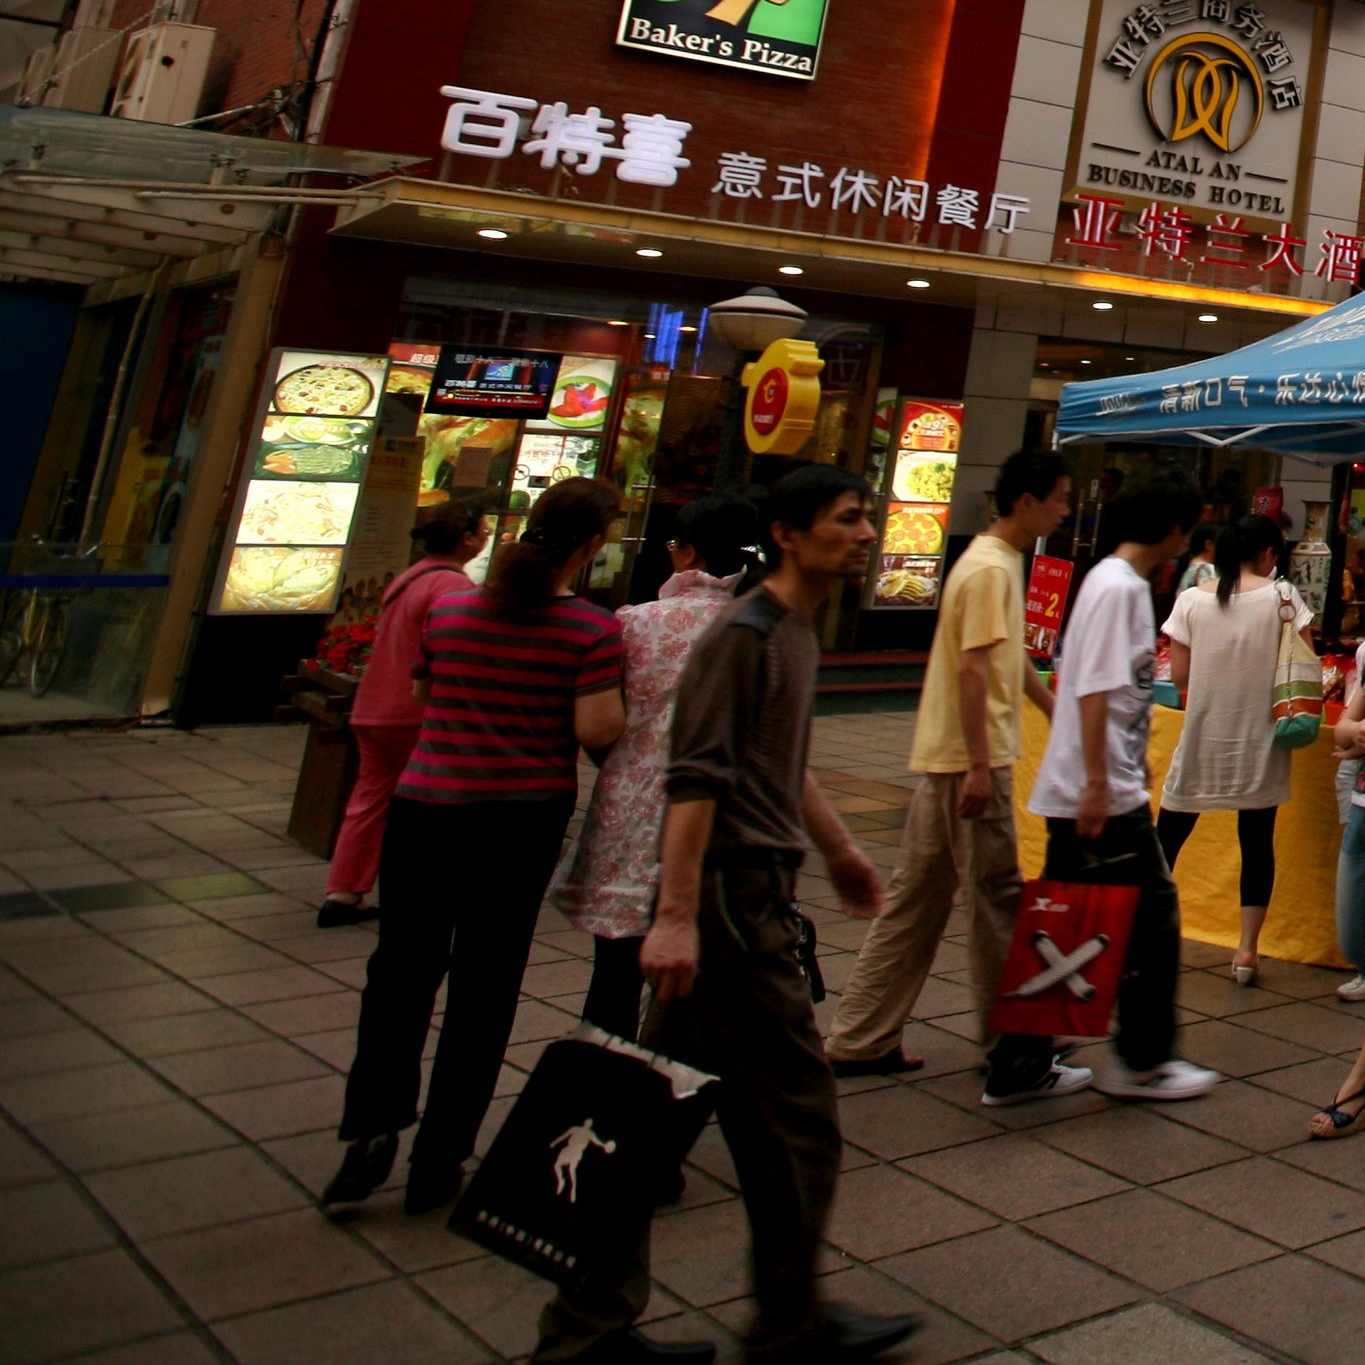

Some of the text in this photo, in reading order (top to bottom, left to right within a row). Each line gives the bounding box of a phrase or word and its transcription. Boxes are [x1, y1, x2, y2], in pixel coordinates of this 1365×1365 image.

[629, 17, 814, 73] Baker's Pizza
[439, 83, 693, 188] 百特喜
[711, 150, 1032, 236] 意式休闲餐厅
[1087, 163, 1286, 215] BUSINESS HOTEL
